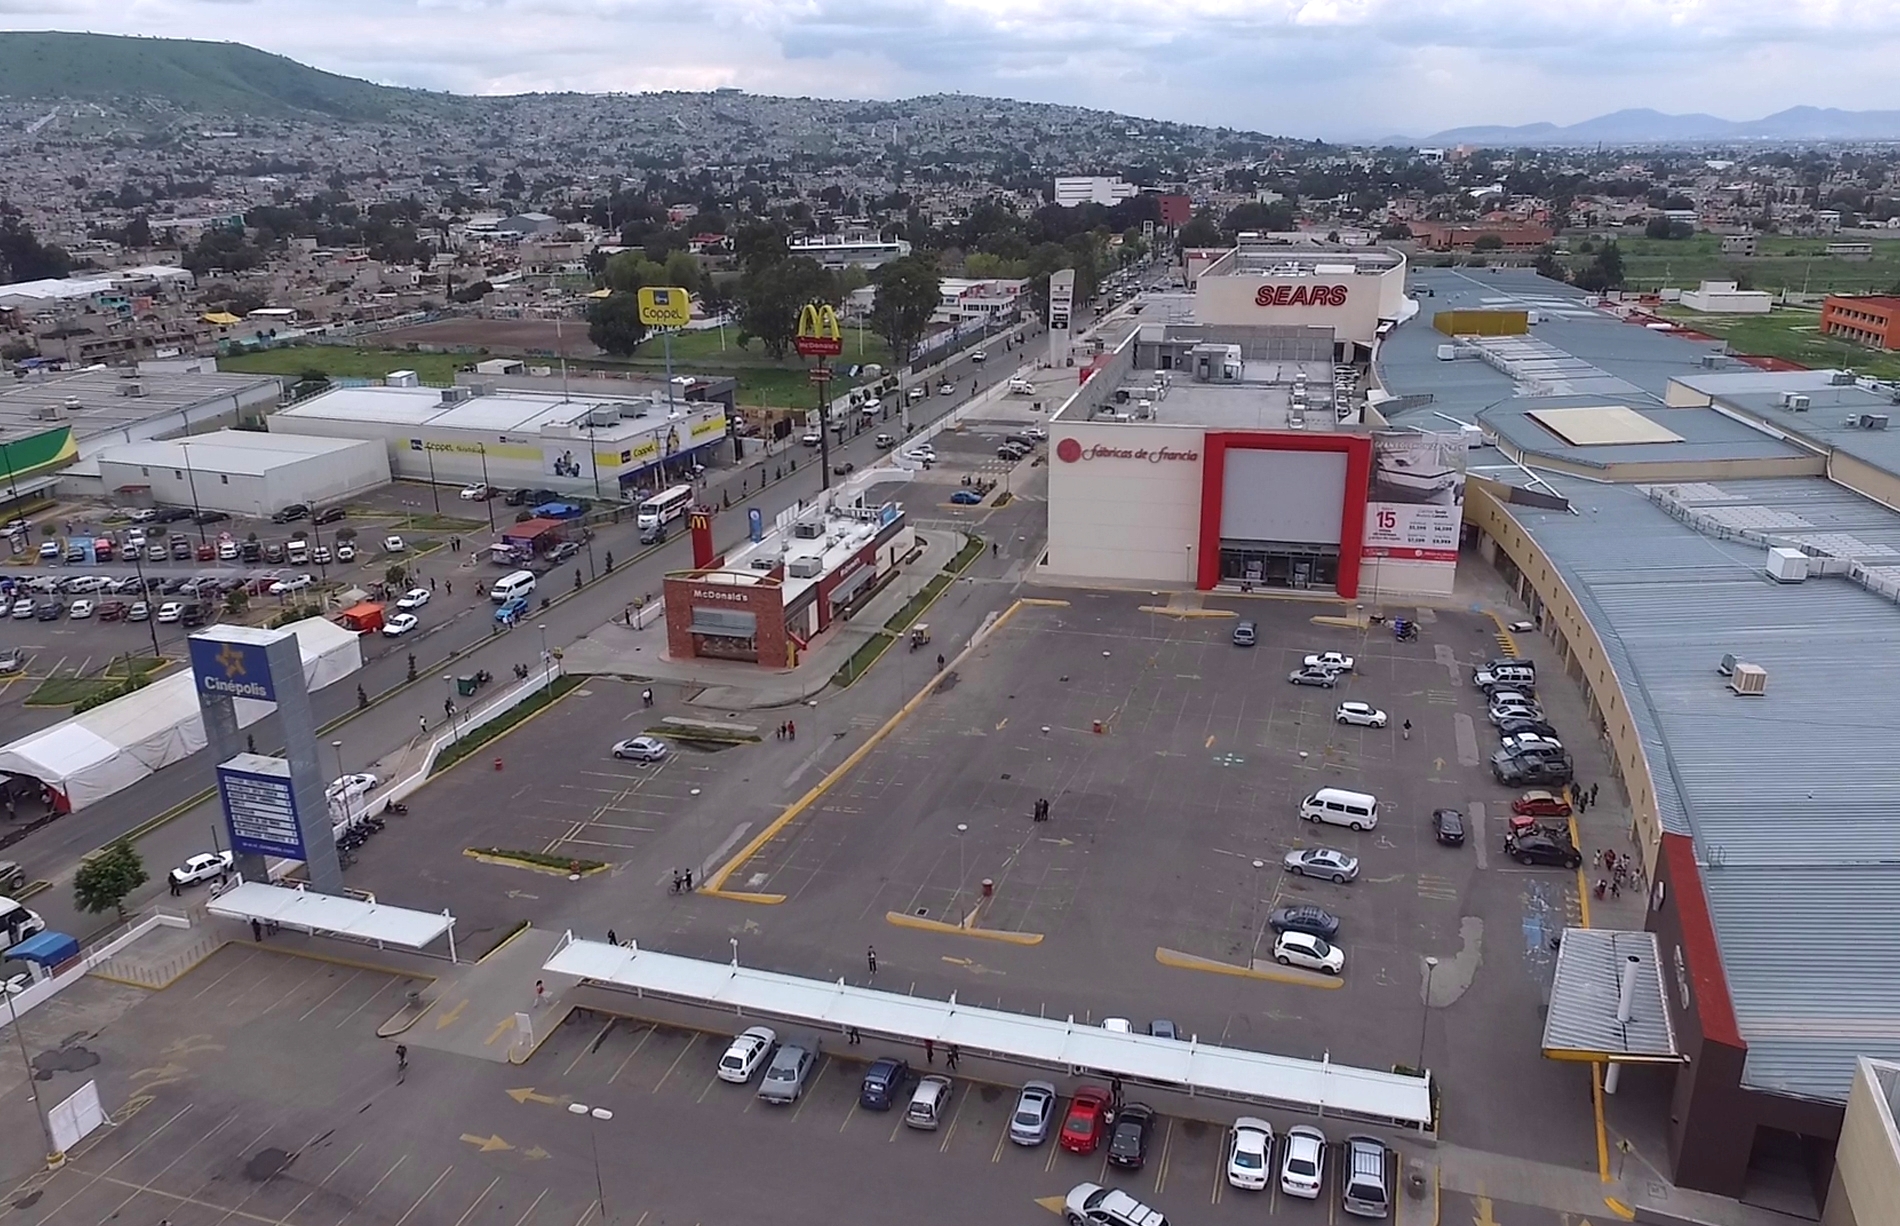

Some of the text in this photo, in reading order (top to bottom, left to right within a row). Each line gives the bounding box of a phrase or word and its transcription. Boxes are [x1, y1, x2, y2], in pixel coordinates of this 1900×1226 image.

[1255, 285, 1348, 306] SEARS
[643, 307, 683, 322] Coppel
[799, 342, 839, 350] McDonald's
[633, 444, 656, 458] Coppel
[1134, 448, 1148, 459] de
[1376, 511, 1397, 529] 15
[694, 590, 748, 602] McDonald's
[204, 676, 267, 696] Cinépolis
